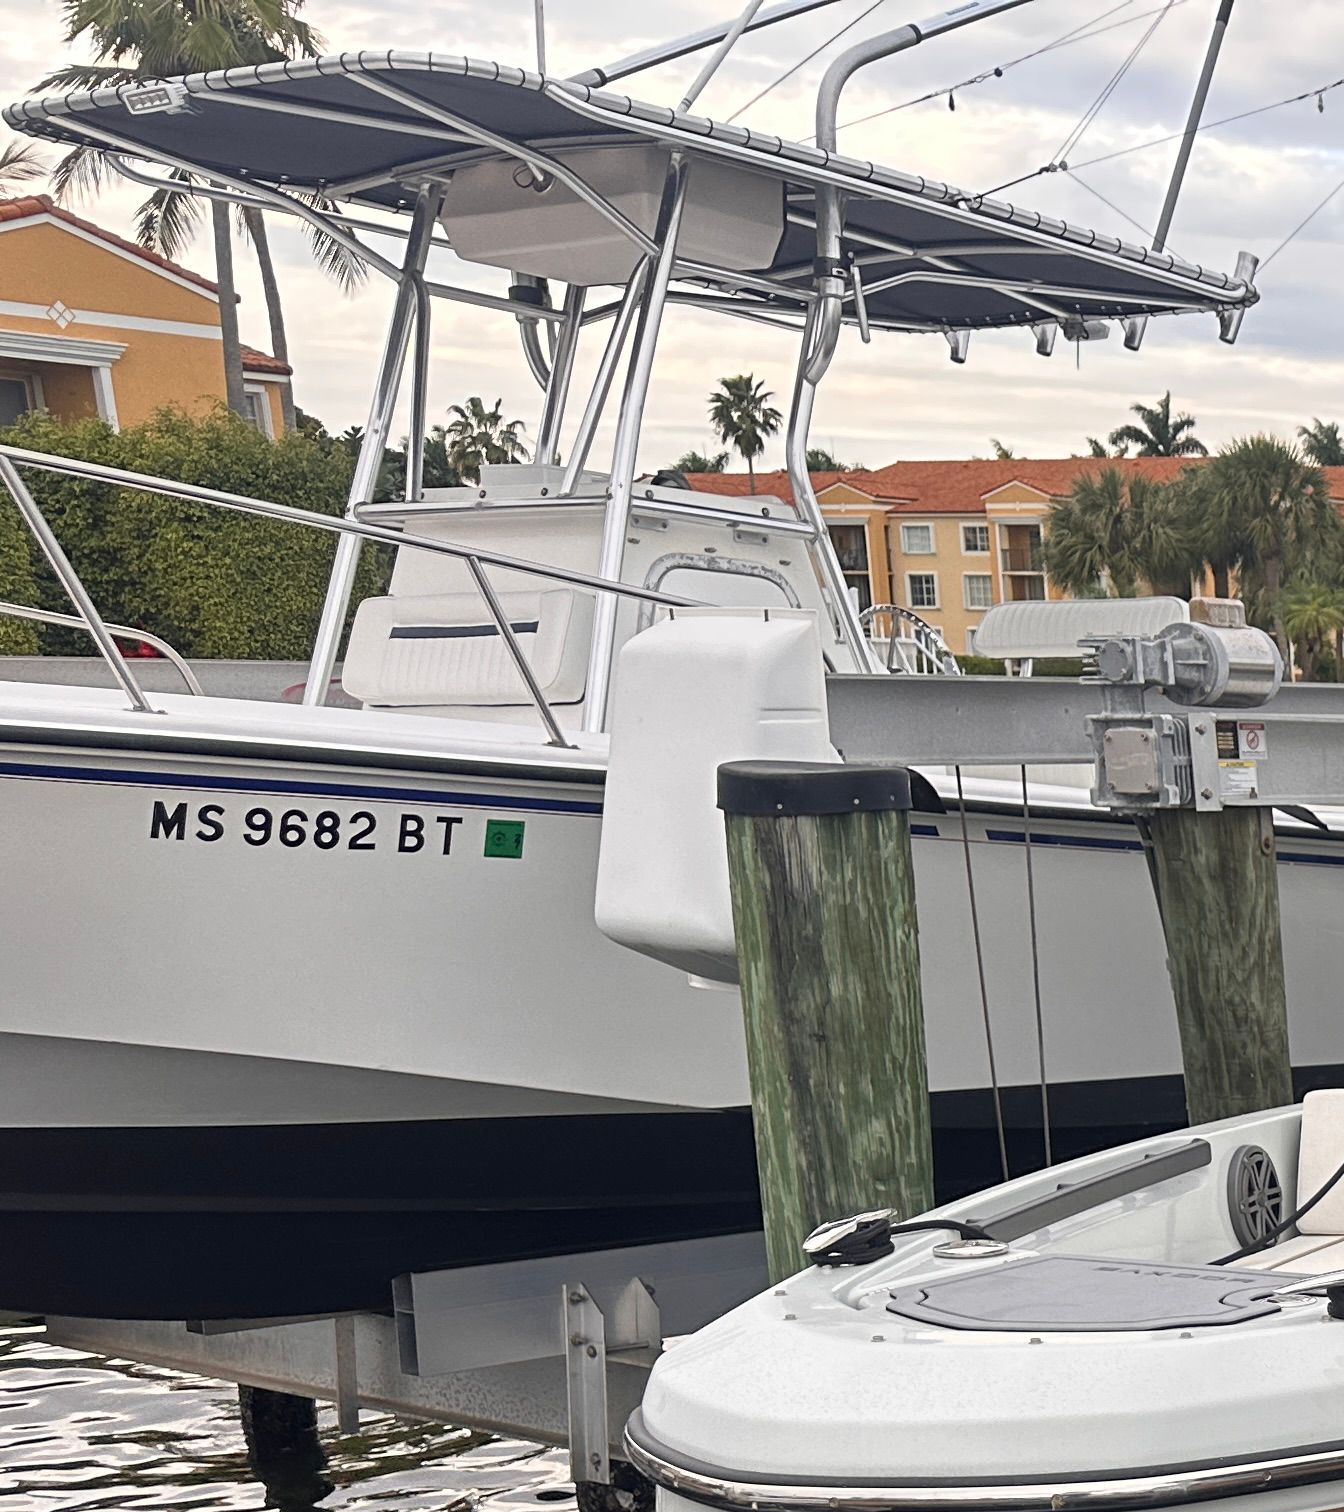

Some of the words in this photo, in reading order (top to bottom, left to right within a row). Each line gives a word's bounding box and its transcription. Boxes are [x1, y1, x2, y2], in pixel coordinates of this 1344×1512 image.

[150, 801, 225, 842] MS
[243, 807, 377, 850] 9682
[397, 813, 463, 856] BT
